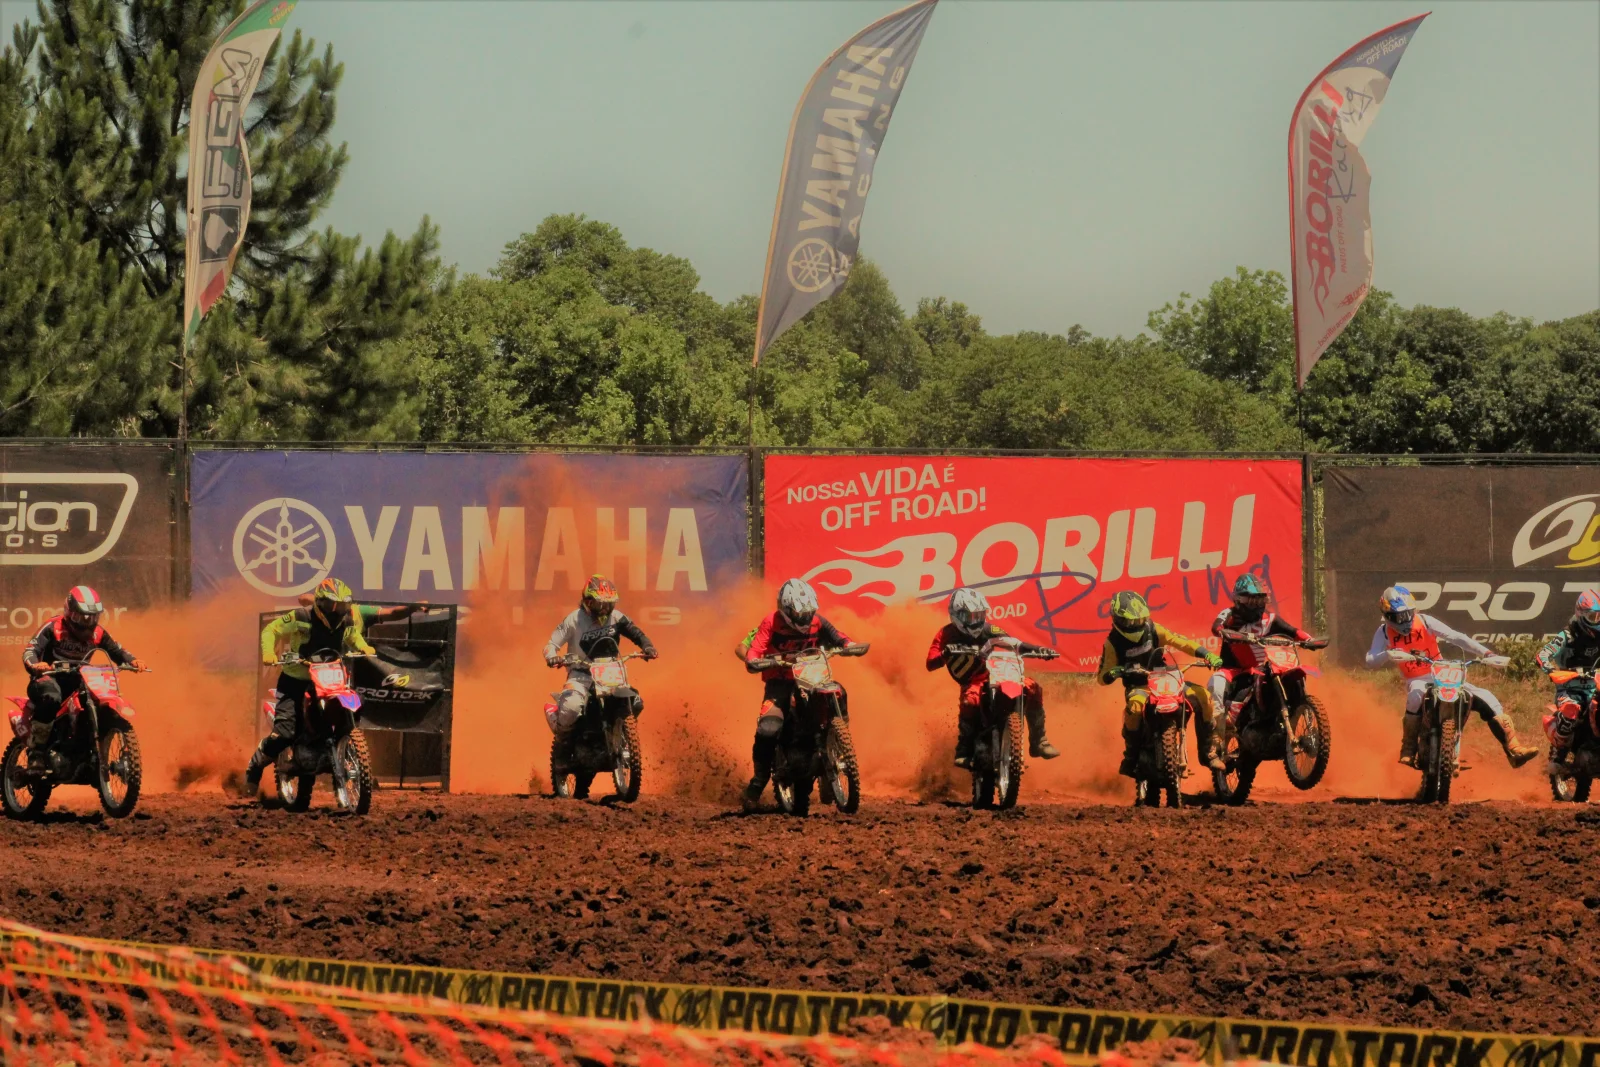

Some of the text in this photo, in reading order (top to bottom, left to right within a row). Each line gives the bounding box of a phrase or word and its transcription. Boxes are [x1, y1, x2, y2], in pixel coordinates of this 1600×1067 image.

[1366, 36, 1406, 65] OFF ROAD!
[798, 45, 894, 231] YAMAHA
[1306, 79, 1344, 278] BORILLI
[1336, 205, 1347, 274] PNEUS OFF ROAD
[787, 463, 955, 504] NOSSA VIDA É
[821, 487, 986, 532] OFF ROAD!
[344, 505, 708, 592] YAMAHA
[888, 493, 1256, 606] BORILLI
[1382, 581, 1551, 621] PRO
[356, 686, 435, 700] PRO TORK
[499, 976, 669, 1021] PRO TORK
[718, 990, 800, 1035] PRO
[1030, 1010, 1158, 1056] TORK
[1230, 1023, 1497, 1067] PRO TORK
